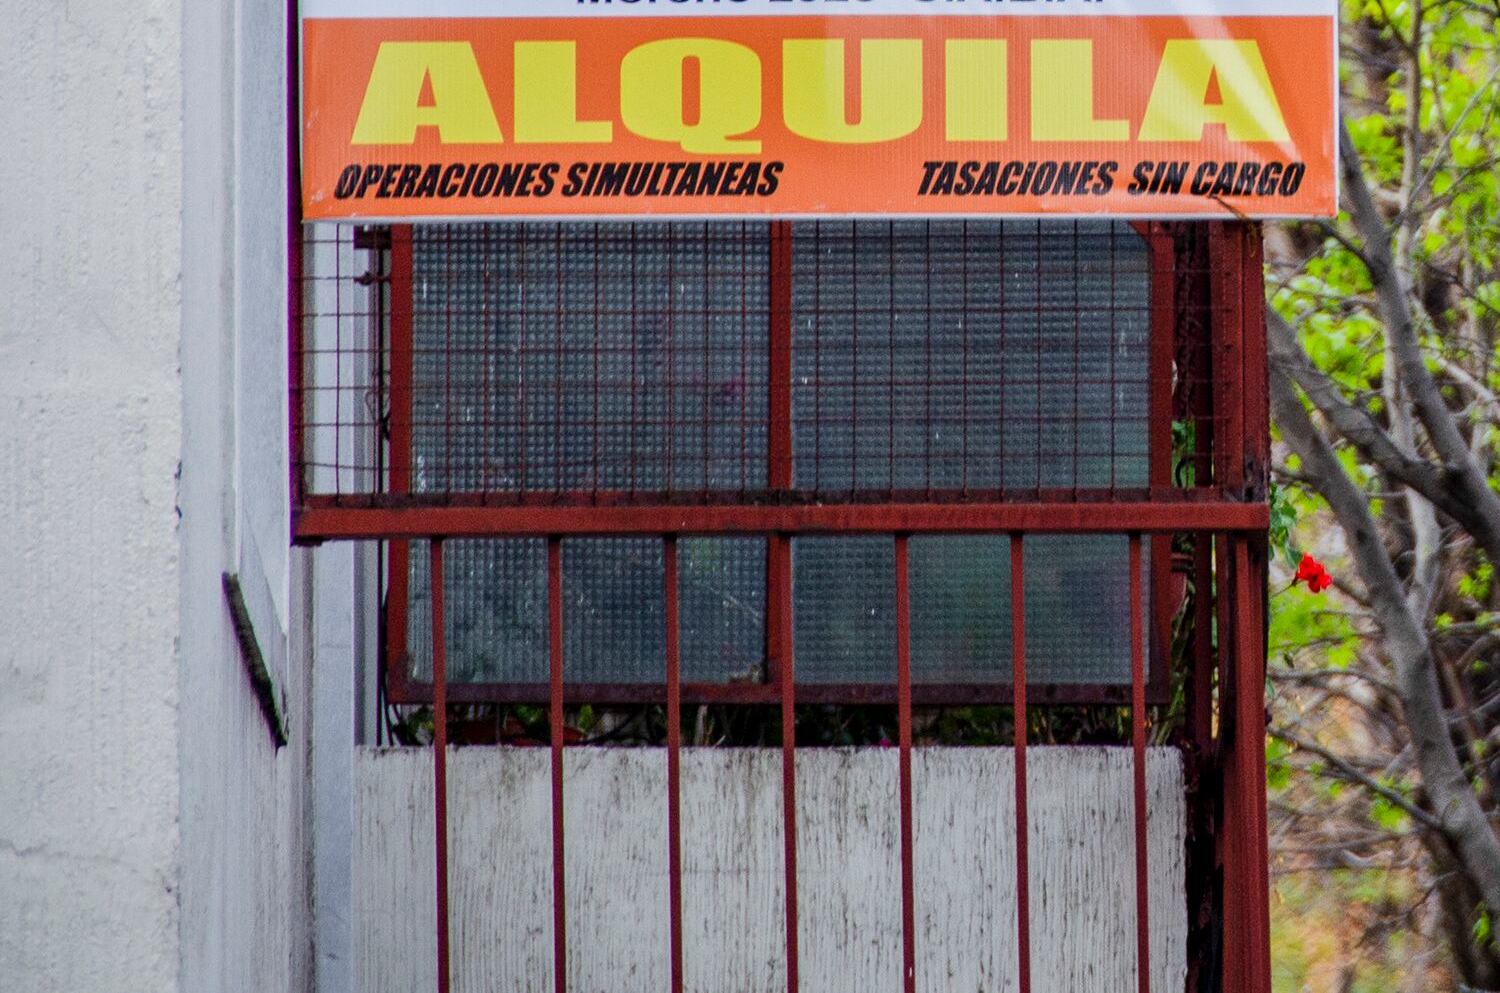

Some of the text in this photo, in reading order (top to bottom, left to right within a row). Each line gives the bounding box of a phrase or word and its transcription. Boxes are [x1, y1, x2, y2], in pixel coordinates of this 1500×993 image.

[350, 37, 1293, 155] ALQUILA
[333, 161, 785, 198] OPERACIONES SIMULTANEAS
[917, 160, 1306, 196] TASACIONES SIN CARGO
